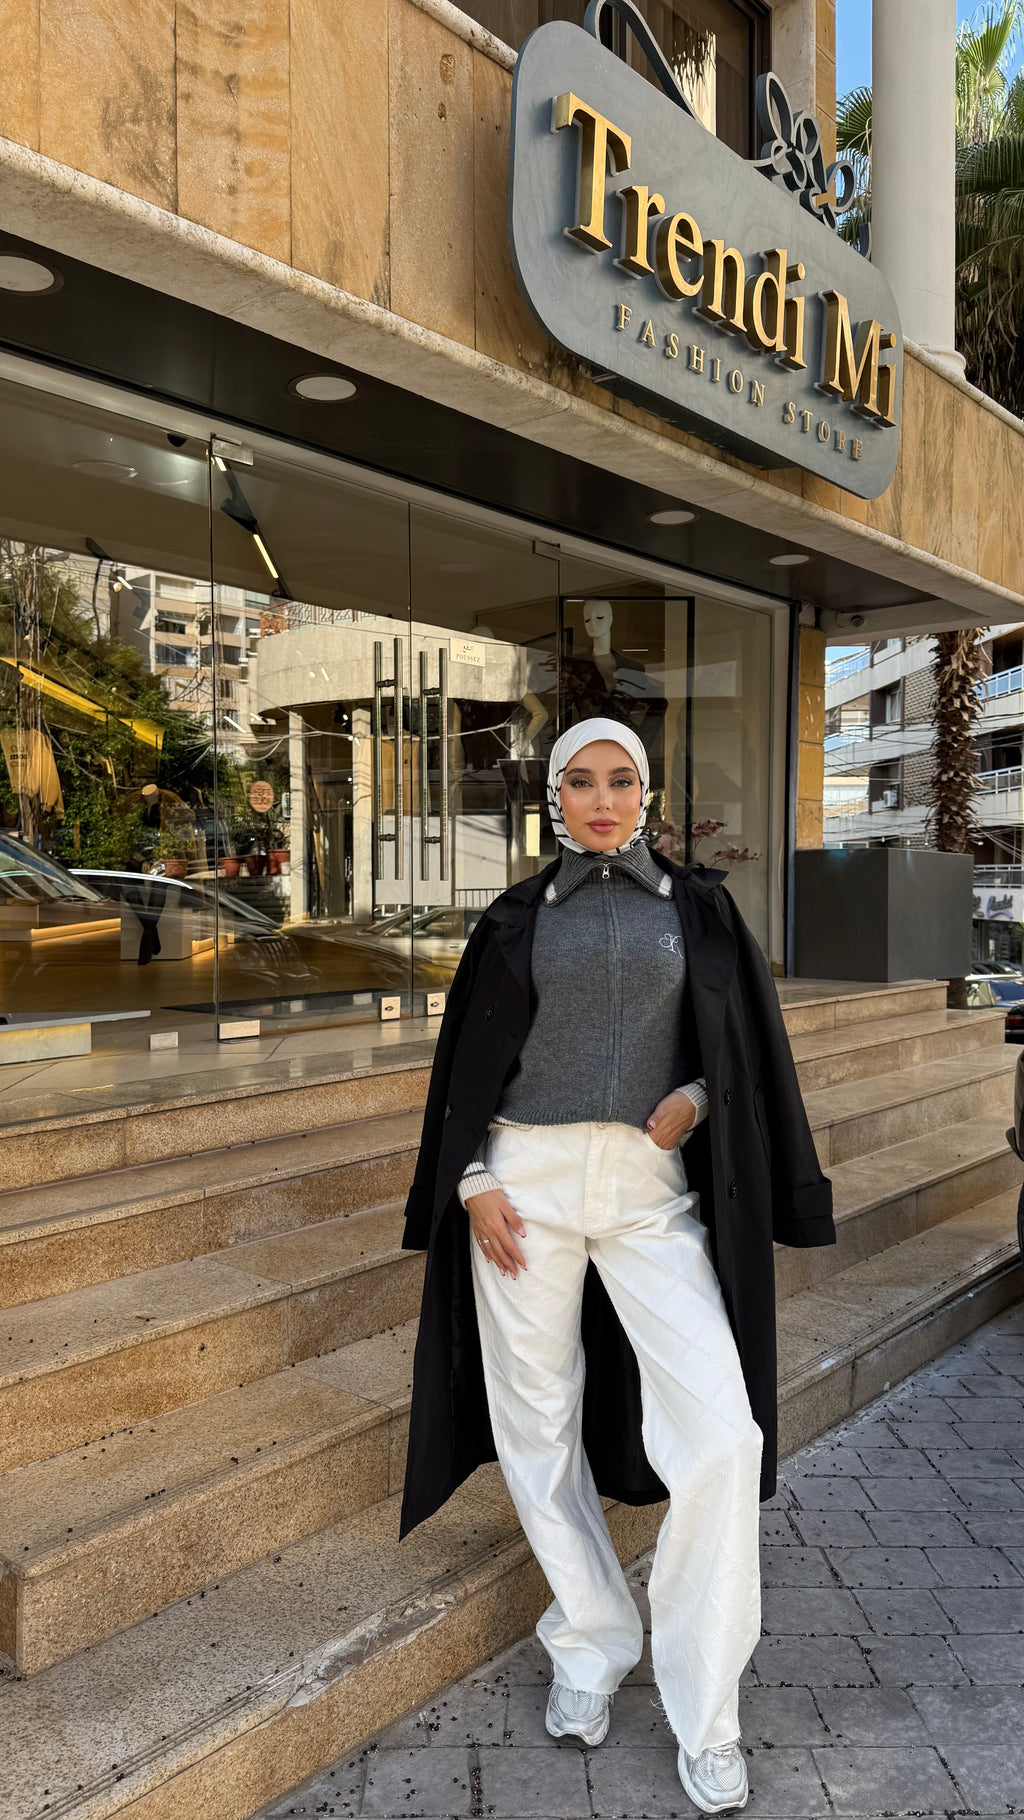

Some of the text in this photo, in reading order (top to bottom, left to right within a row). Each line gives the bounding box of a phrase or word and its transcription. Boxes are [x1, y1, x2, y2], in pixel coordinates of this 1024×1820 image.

[551, 92, 897, 429] Trendi Mi
[615, 303, 864, 461] FASHION STORE
